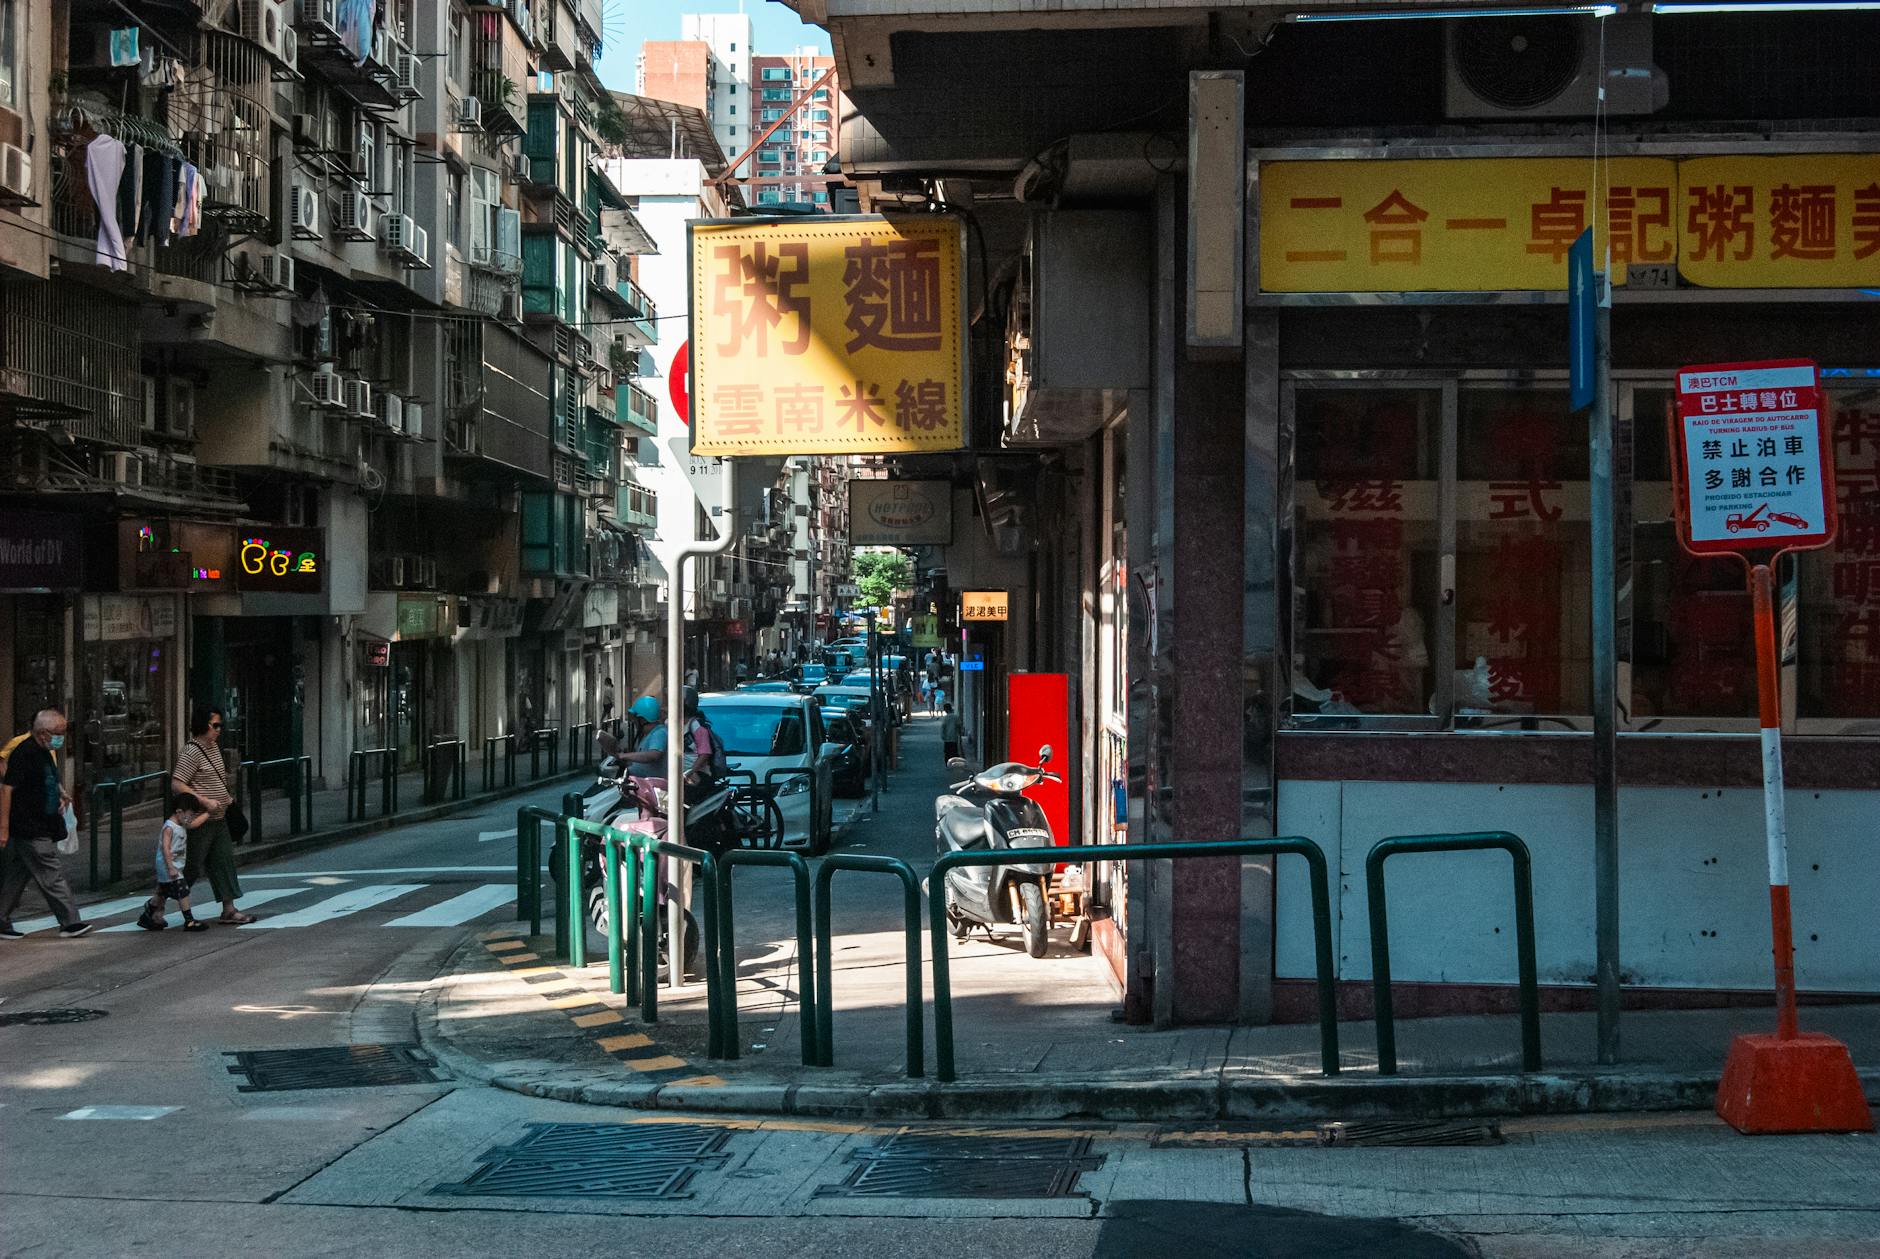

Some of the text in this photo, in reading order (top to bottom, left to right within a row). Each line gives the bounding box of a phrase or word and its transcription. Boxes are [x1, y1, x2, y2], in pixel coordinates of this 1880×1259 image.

[1651, 268, 1669, 286] 74
[713, 237, 943, 358] 粥麵
[1688, 376, 1738, 389] 澳巴TCM
[713, 378, 949, 436] 雲南米線
[1701, 389, 1798, 413] 巴士轉彎位
[1723, 417, 1754, 425] VIRAGEM
[1702, 435, 1804, 460] 禁止泊車
[690, 465, 696, 475] 9
[699, 465, 708, 475] 11
[1704, 464, 1806, 490] 多謝合作
[1705, 490, 1792, 501] PROIBIDO ESTACIONAR
[1718, 503, 1753, 511] PARKING
[0, 537, 33, 565] World
[34, 537, 46, 565] of
